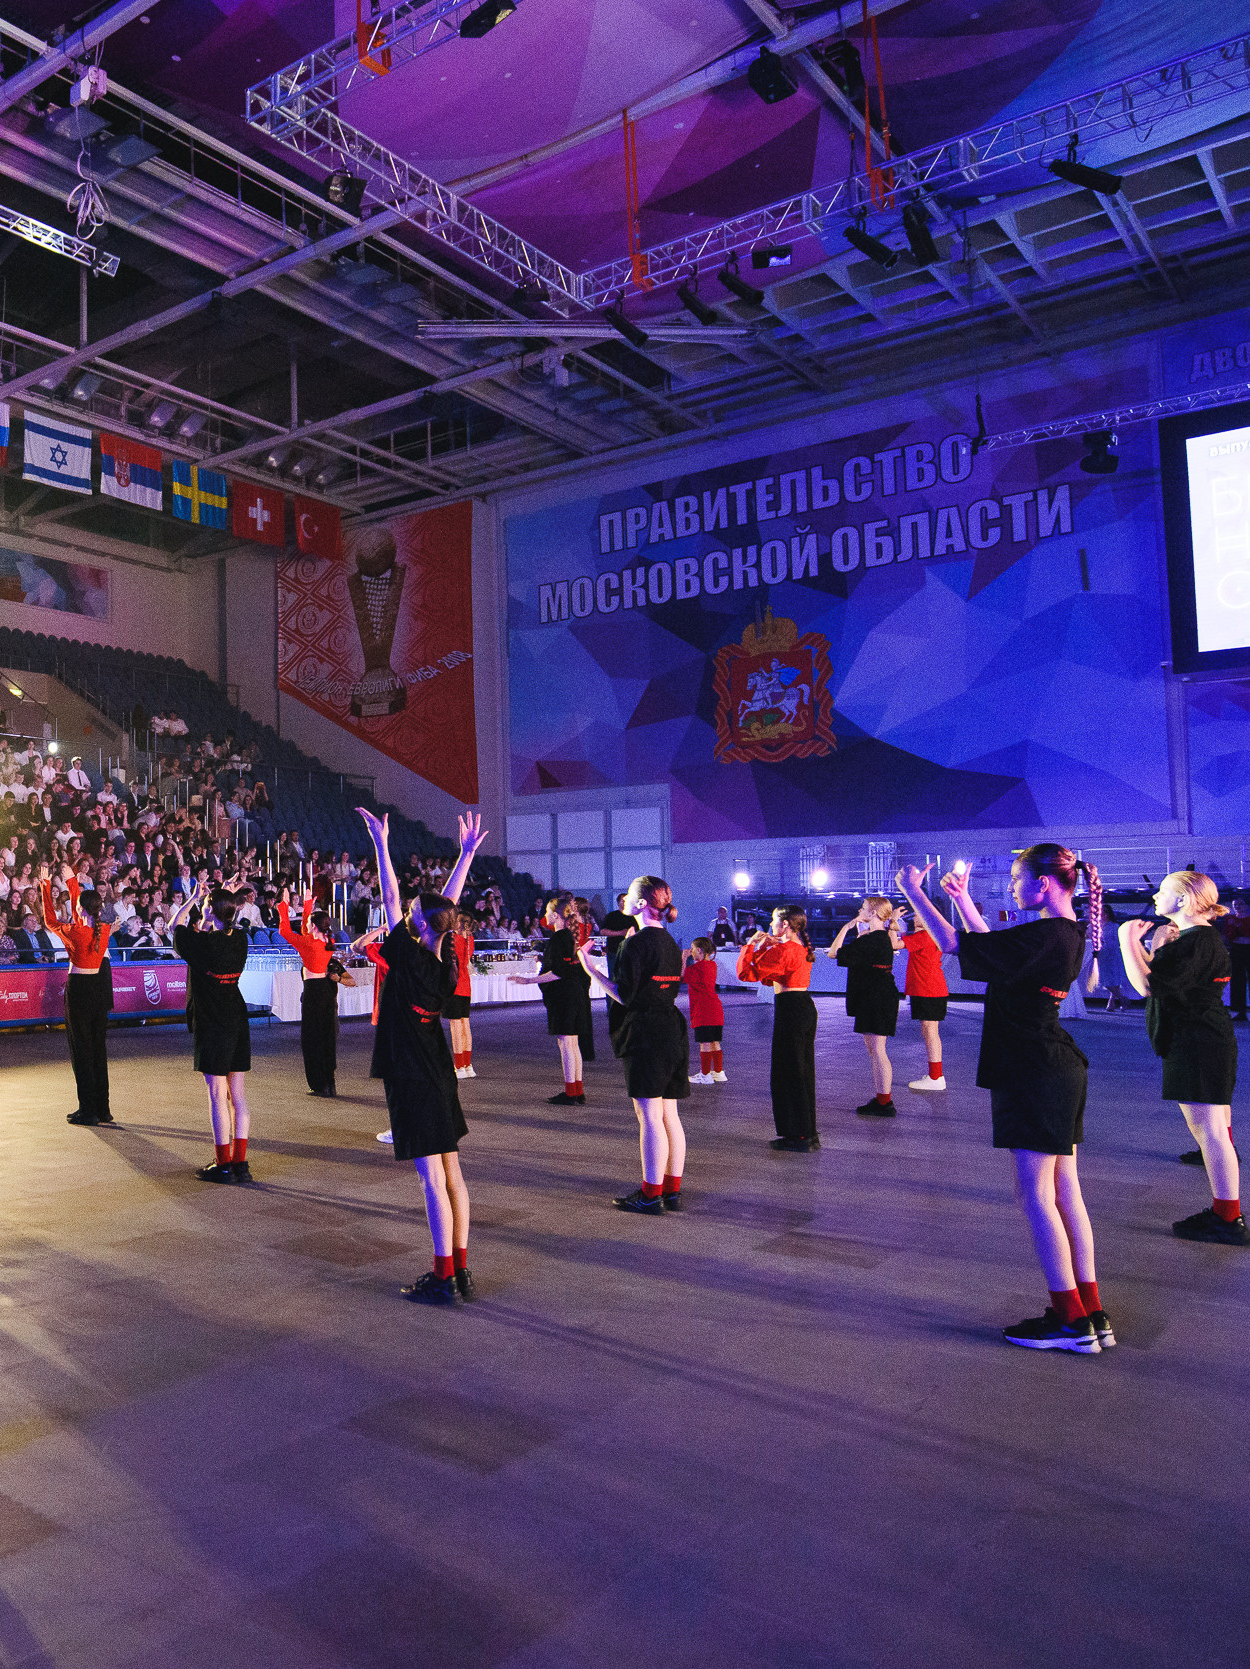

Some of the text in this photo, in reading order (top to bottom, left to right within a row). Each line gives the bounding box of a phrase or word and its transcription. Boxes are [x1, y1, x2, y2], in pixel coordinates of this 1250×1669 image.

[599, 432, 975, 554] ПРАВИТЕЛЬСТВО
[538, 484, 1074, 625] МОСКОВСКОЙ ОБЛАСТИ
[296, 674, 343, 695] ЧЕМПИОН
[349, 676, 405, 696] ЕВРОЛИГИ
[406, 664, 443, 685] ФИБА
